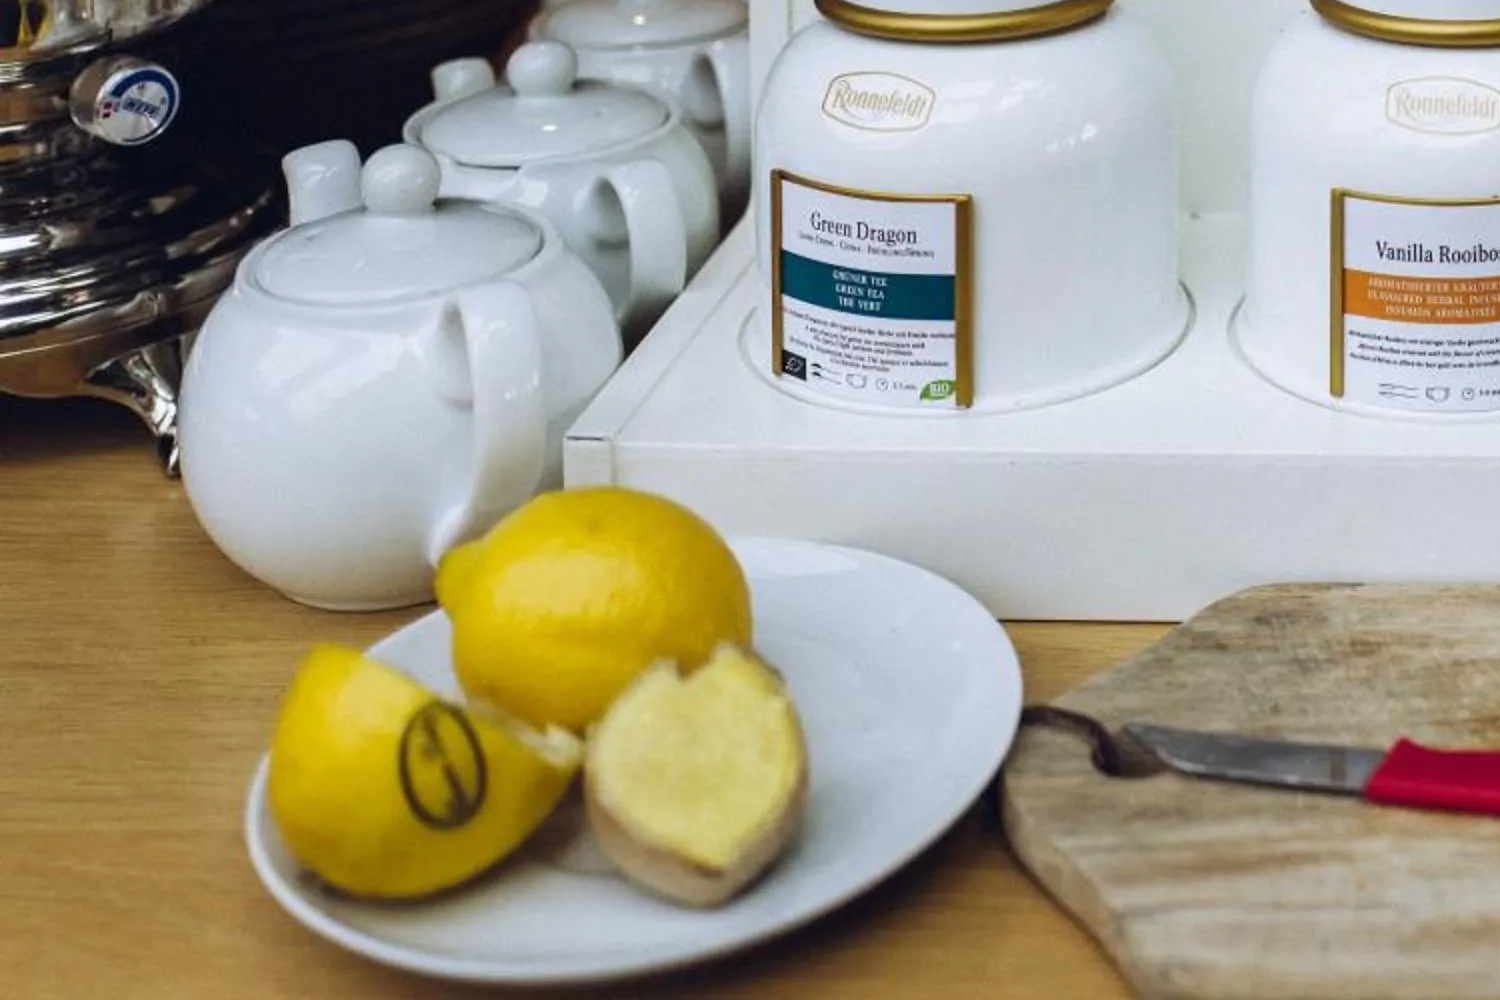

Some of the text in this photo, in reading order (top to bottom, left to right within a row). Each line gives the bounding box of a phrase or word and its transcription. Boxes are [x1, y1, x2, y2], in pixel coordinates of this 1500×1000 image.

[831, 79, 927, 119] Ronnefeldt
[810, 210, 918, 246] Green Dragon
[1375, 239, 1434, 263] Vanilla
